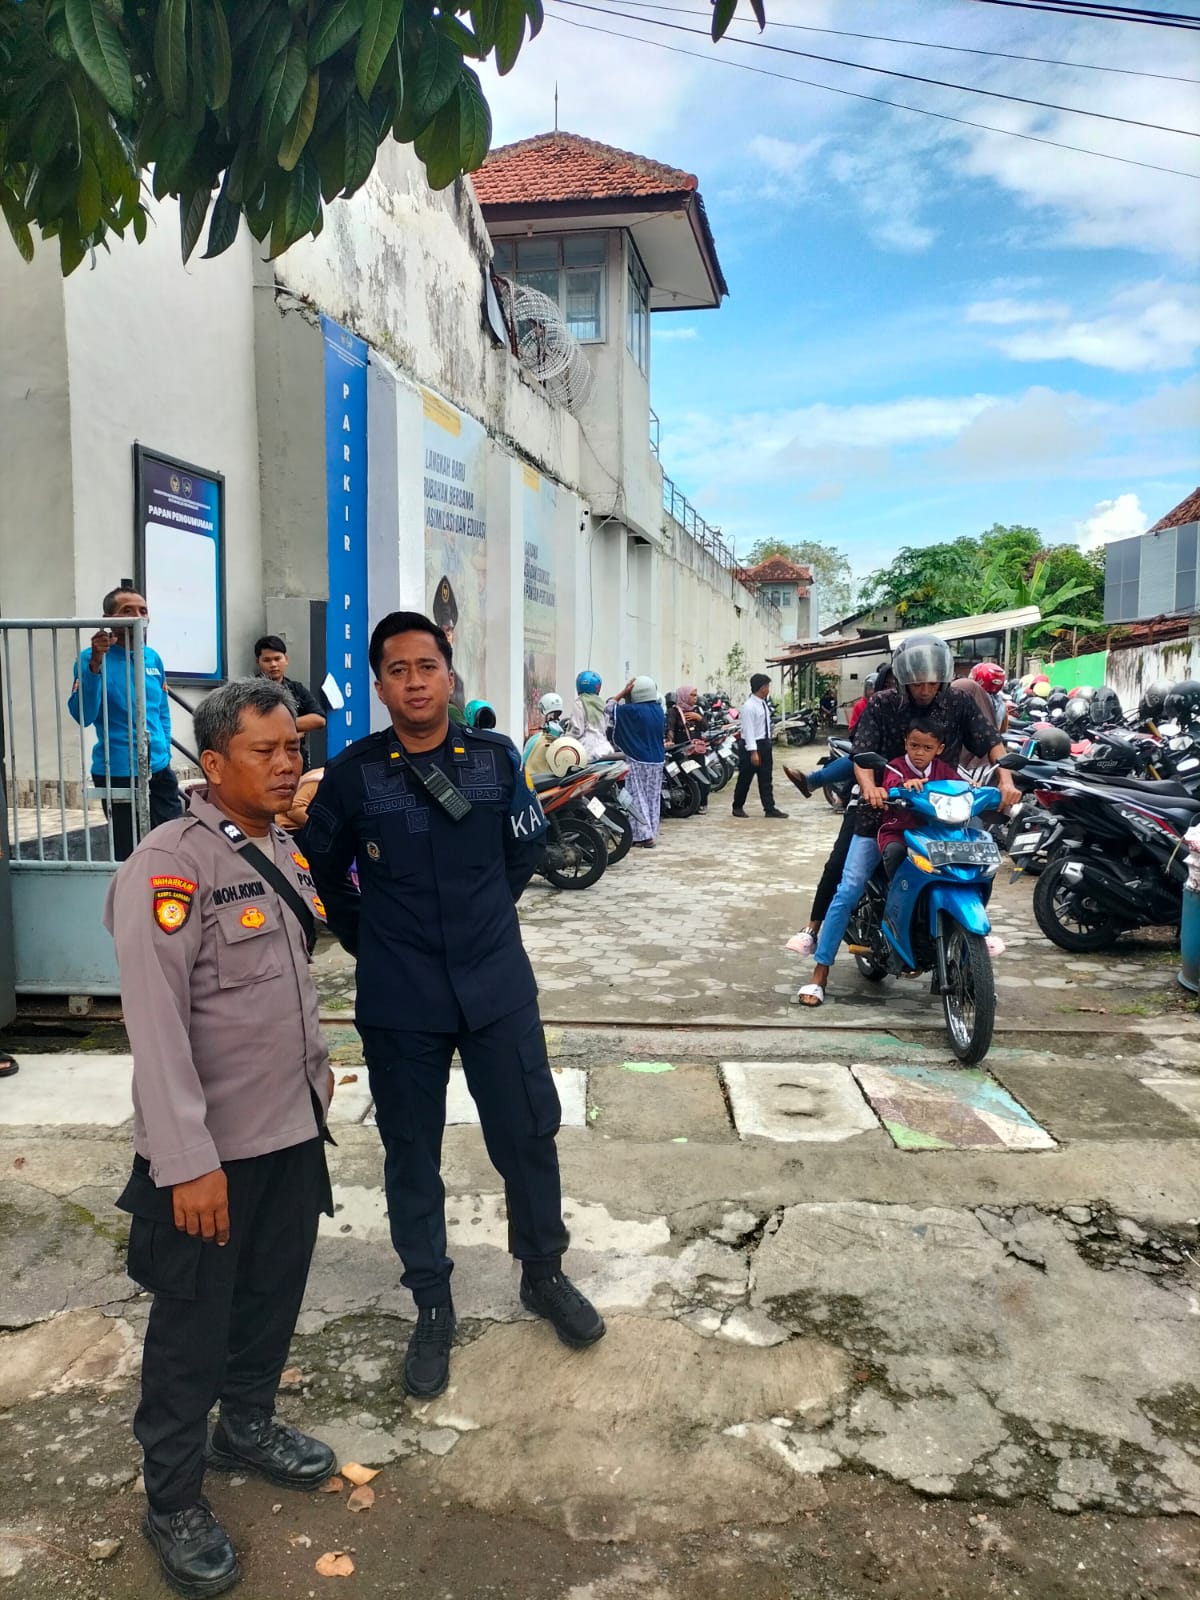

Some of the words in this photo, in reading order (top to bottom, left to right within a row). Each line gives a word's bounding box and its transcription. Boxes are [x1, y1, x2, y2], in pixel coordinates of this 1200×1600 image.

[342, 382, 351, 552] PARKIR
[425, 448, 450, 477] LANGKAH
[451, 459, 466, 482] BARU
[449, 485, 474, 511] BERSAMA
[148, 504, 171, 520] PAPAN
[171, 511, 214, 531] PENGUMUMAN
[426, 506, 455, 531] ASIMILASI
[455, 513, 467, 535] DAN
[367, 797, 412, 815] PRABOWO
[461, 789, 499, 799] MIPAS
[510, 797, 544, 838] KA
[152, 876, 194, 891] BAHARKAM
[297, 872, 318, 888] POL
